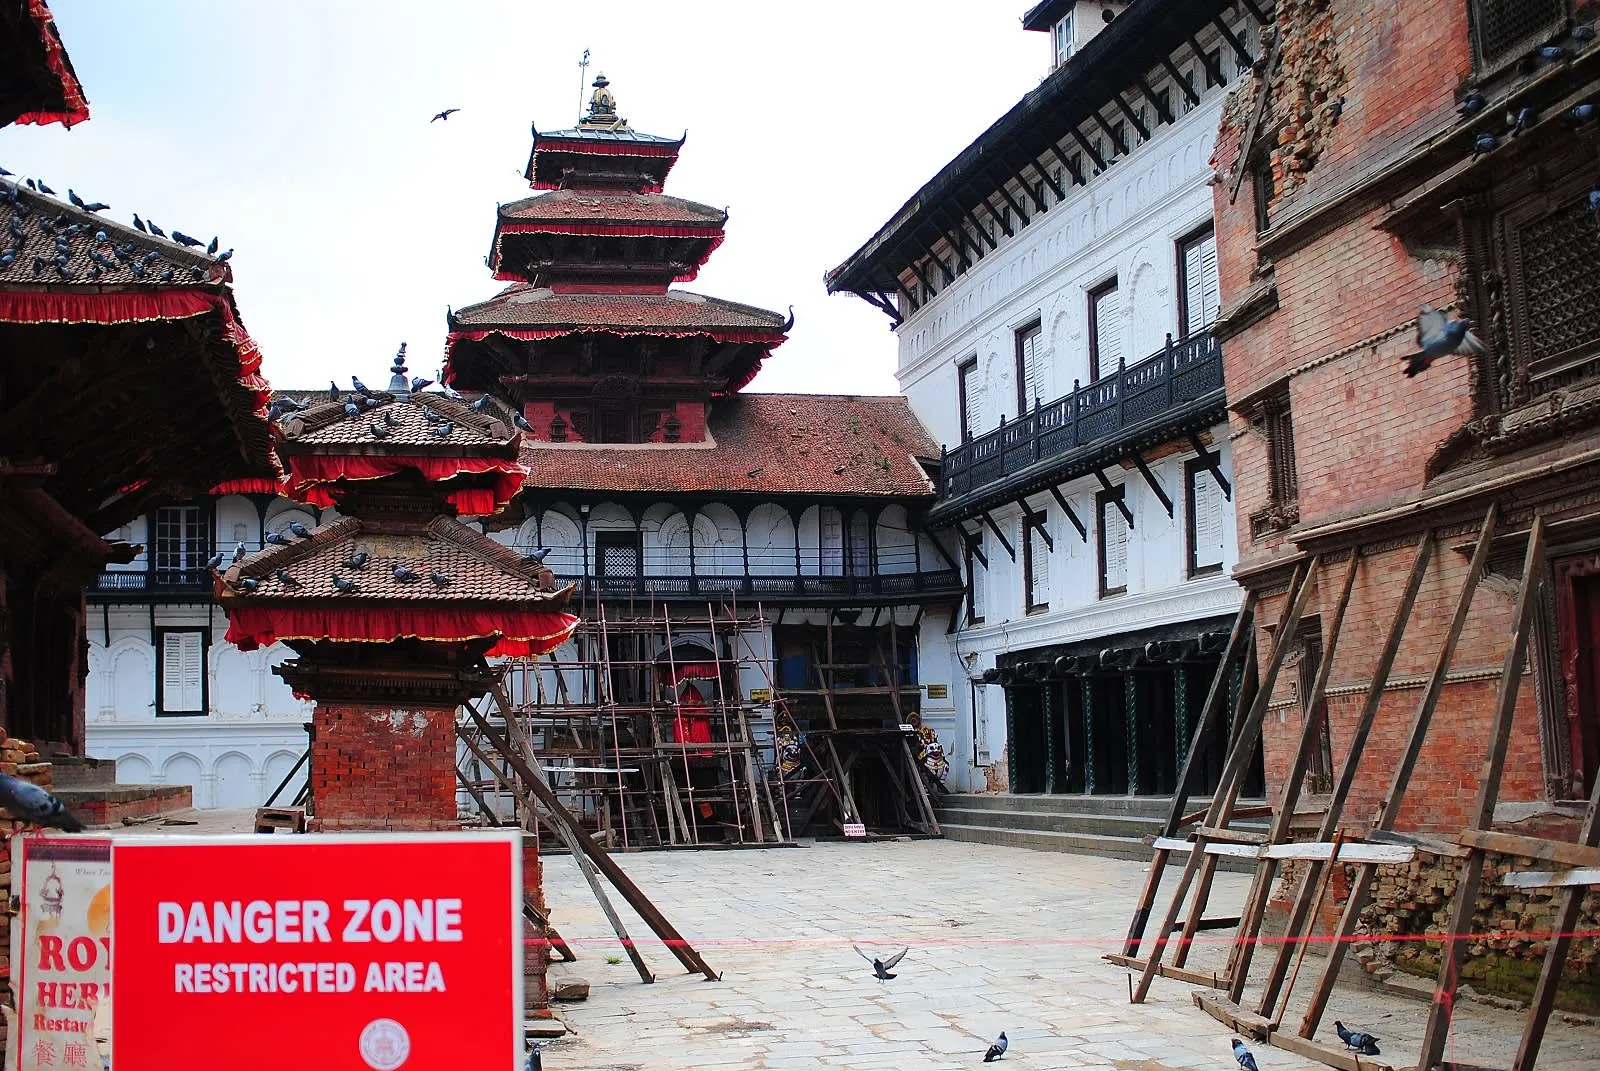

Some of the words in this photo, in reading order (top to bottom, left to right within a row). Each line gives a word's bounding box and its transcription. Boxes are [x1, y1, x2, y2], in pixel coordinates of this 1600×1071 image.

[158, 898, 332, 945] DANGER
[342, 898, 464, 944] ZONE
[174, 962, 356, 994] RESTRICTED
[364, 962, 447, 993] AREA
[37, 981, 110, 1010] HER
